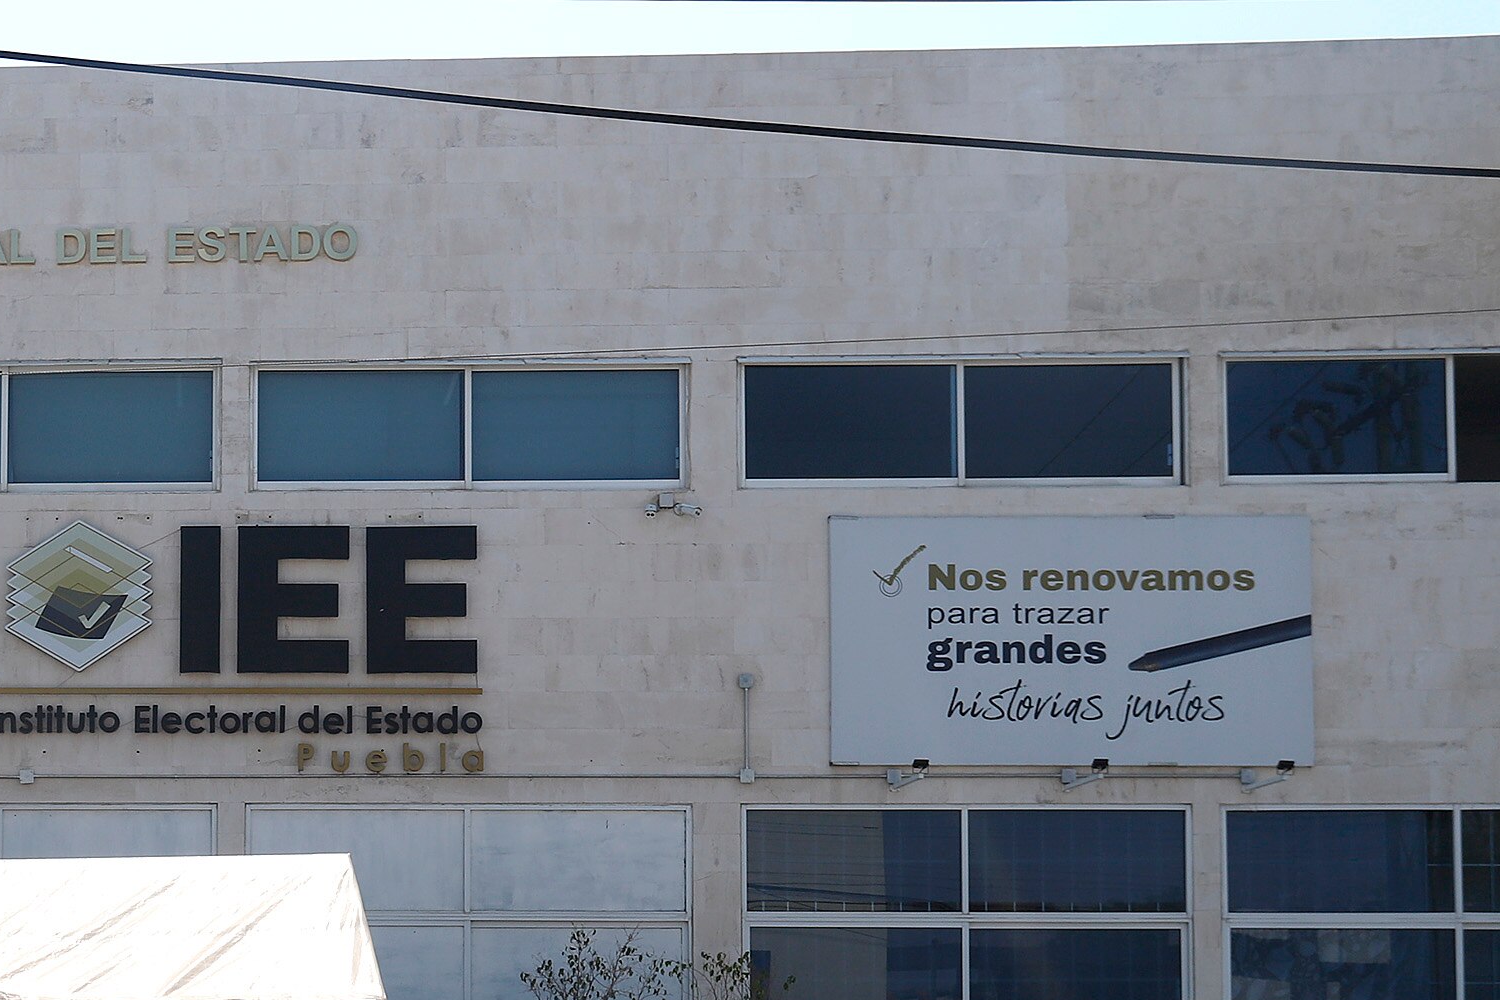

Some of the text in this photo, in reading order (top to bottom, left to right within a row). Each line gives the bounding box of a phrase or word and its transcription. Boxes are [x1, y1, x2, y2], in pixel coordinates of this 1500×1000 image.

[56, 226, 148, 265] DEL
[166, 221, 360, 264] ESTADO
[927, 563, 1256, 591] Nos renovamos
[180, 525, 478, 674] IEE
[927, 603, 1110, 629] para trazar
[926, 634, 1107, 671] grandes
[134, 705, 286, 735] Electoral
[298, 705, 353, 735] del
[367, 705, 483, 735] Estado
[946, 678, 1225, 740] historias juntos
[297, 742, 484, 773] Puebla
